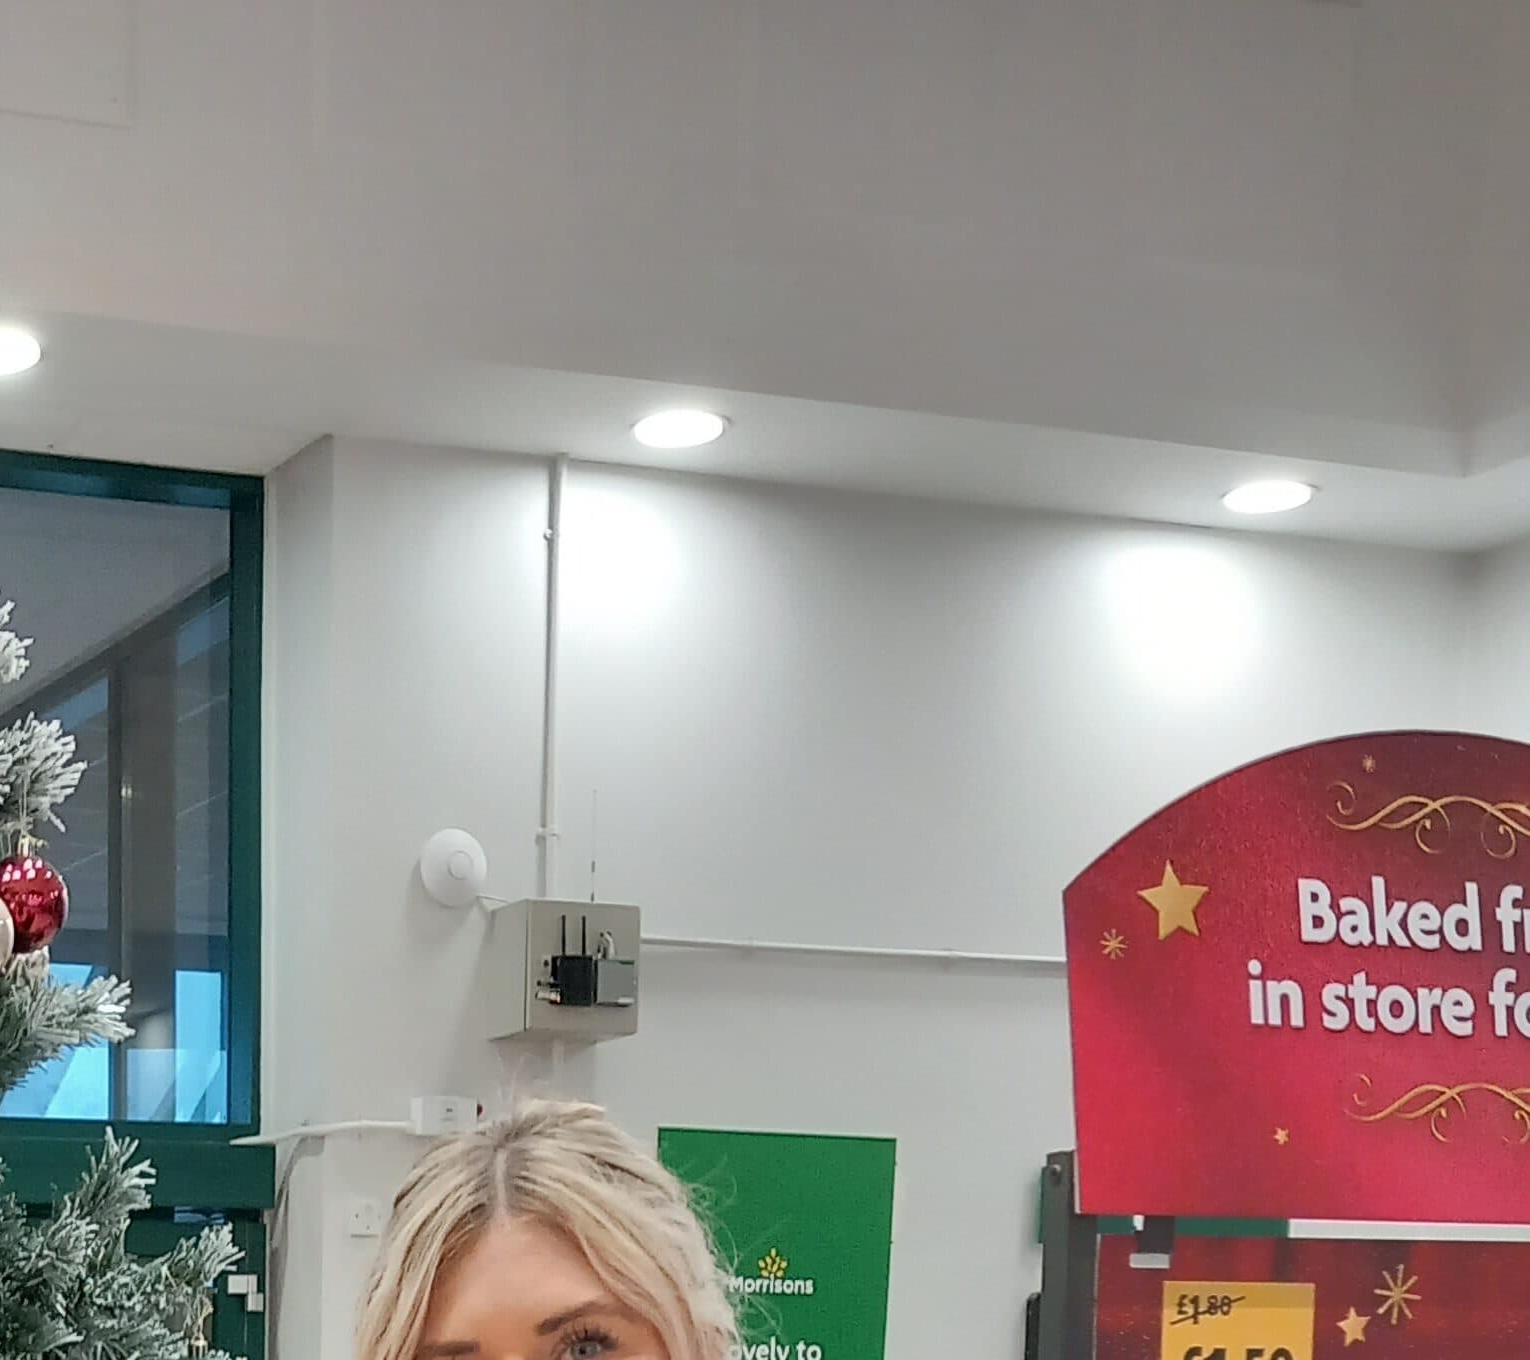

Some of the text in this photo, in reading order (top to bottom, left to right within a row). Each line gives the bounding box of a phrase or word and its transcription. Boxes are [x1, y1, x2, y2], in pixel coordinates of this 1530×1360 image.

[1297, 875, 1530, 953] Baked f
[1247, 959, 1305, 1029] in
[1321, 970, 1475, 1037] store
[729, 1275, 814, 1295] Morrisons
